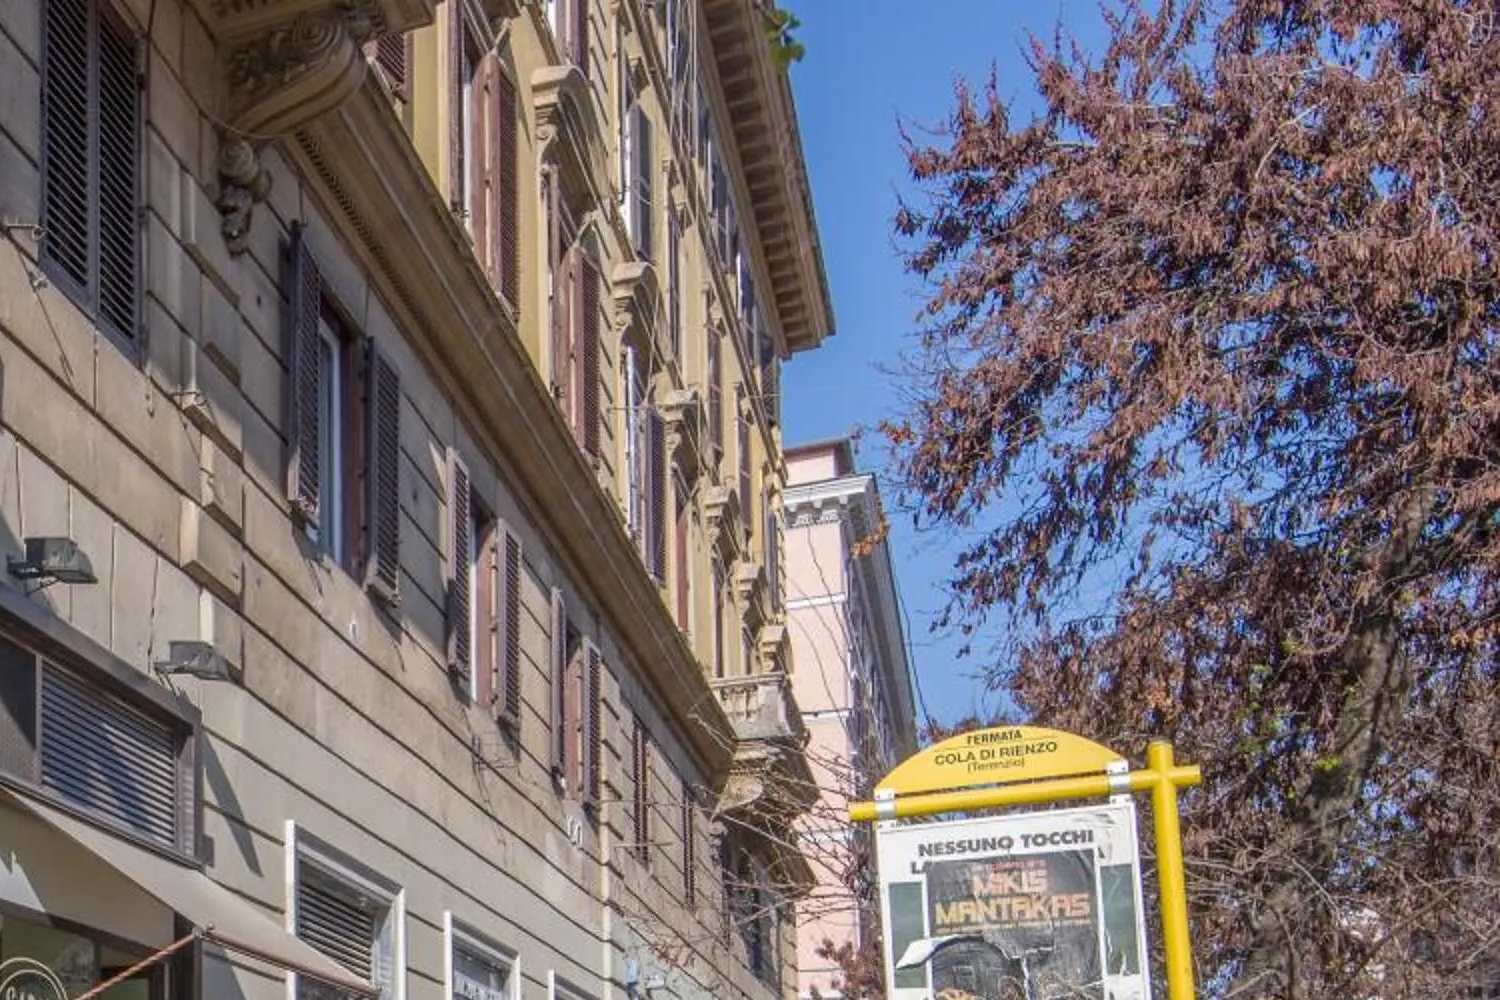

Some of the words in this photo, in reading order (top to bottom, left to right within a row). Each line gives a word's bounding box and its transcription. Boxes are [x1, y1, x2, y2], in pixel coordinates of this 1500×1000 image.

[967, 729, 1022, 745] FERMATA
[934, 751, 977, 766] COLA
[979, 749, 996, 759] DI
[999, 740, 1058, 757] RIENZO
[967, 757, 1025, 773] (Terenzio)
[918, 836, 1013, 857] NESSUNO
[1021, 829, 1094, 849] TOCCHI
[934, 893, 1091, 926] MANTAKAS
